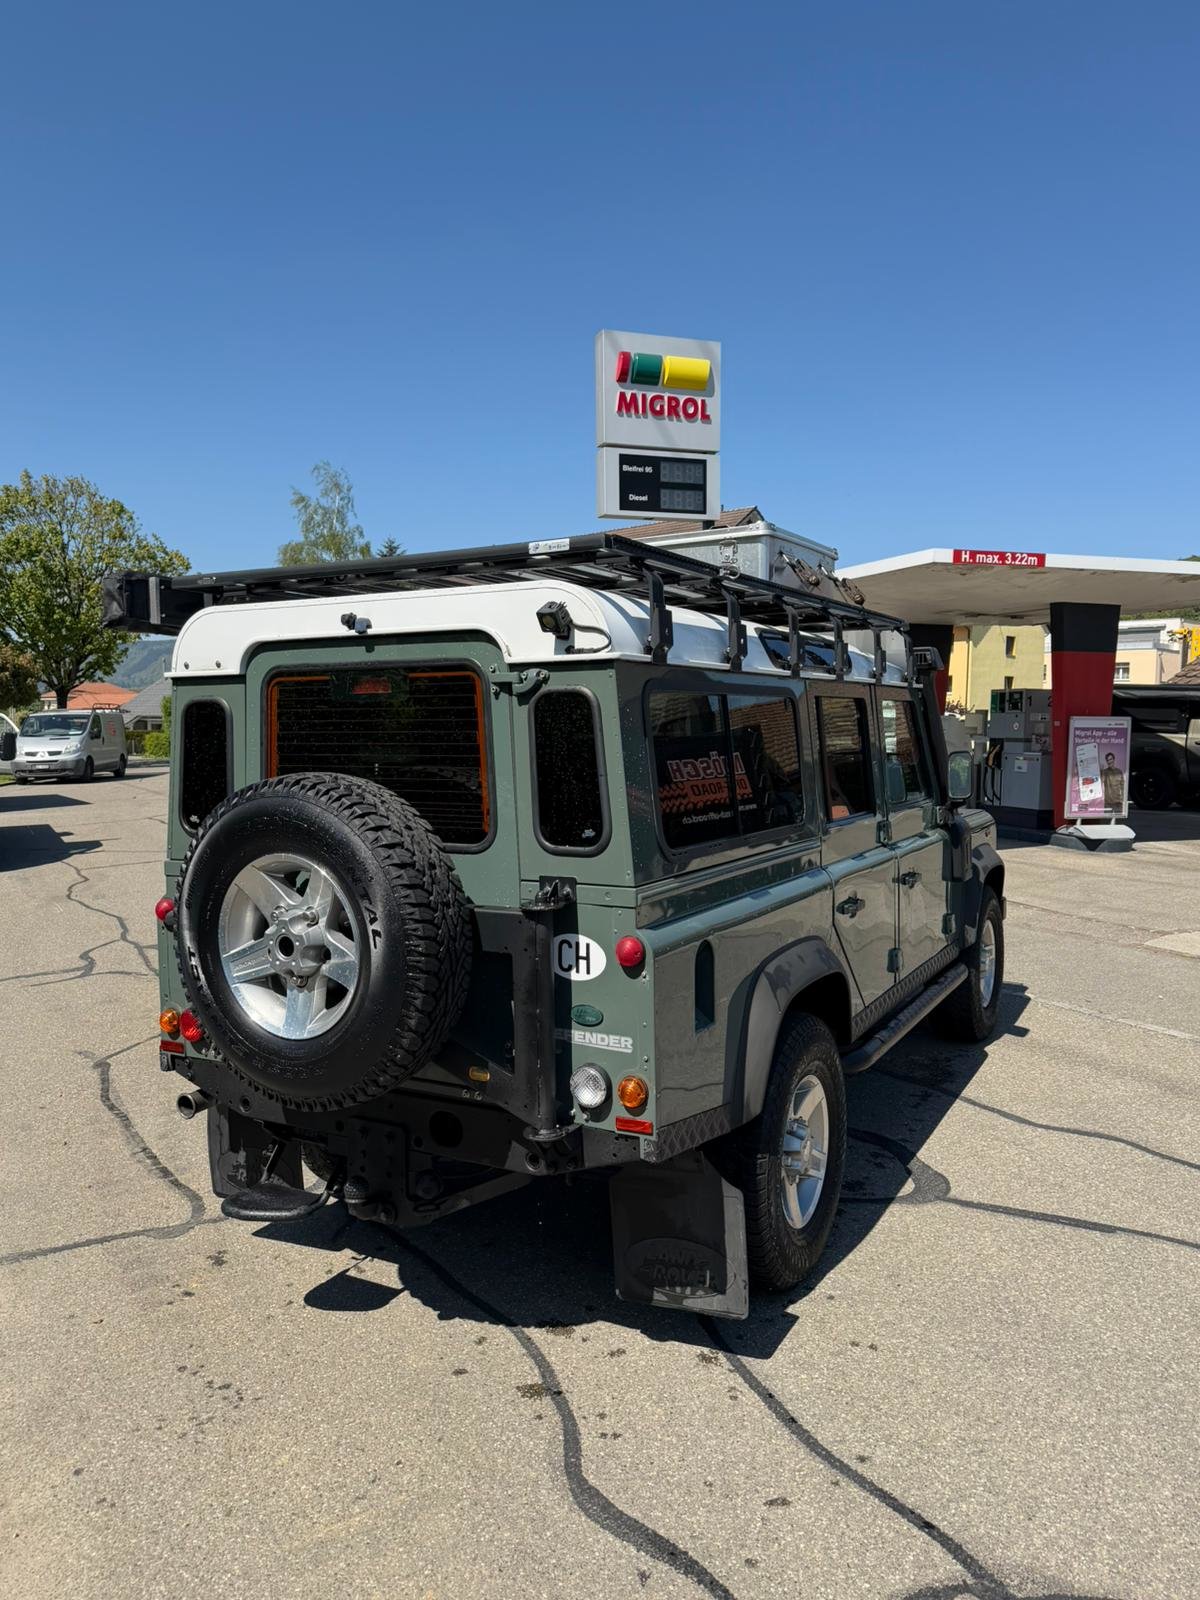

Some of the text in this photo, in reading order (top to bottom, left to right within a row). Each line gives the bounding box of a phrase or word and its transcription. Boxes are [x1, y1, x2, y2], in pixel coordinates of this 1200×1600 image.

[616, 391, 711, 422] MIGROL
[622, 464, 644, 473] Bleifrei
[628, 493, 648, 502] Diesel
[961, 550, 1038, 566] H. max. 3.22m
[558, 939, 591, 975] CH
